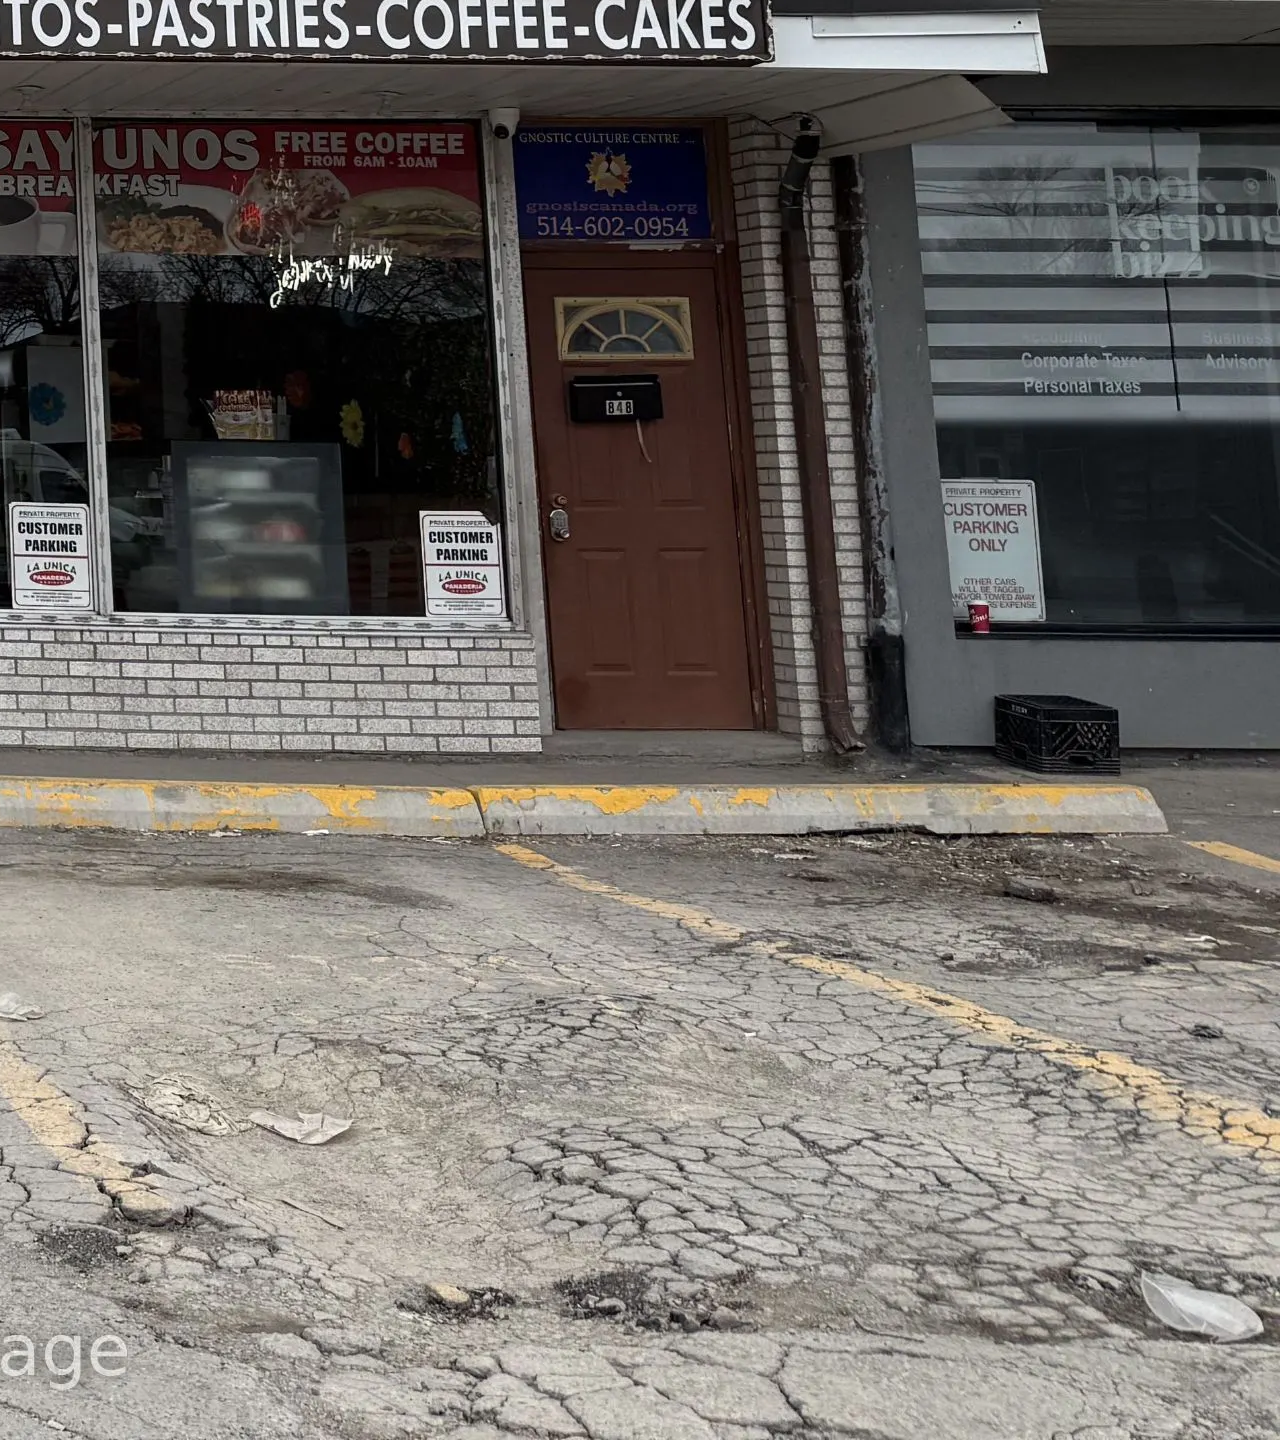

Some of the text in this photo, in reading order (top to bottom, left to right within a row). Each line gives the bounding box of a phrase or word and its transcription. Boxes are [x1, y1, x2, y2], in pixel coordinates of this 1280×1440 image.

[274, 131, 464, 155] FREE COFFEE
[519, 132, 680, 144] GNOSTIC CULTURE CENTRE
[304, 156, 438, 168] FROM 6AM 10AM
[526, 200, 698, 215] gnosiscanada.org
[537, 216, 689, 237] 514-602-0954
[1108, 203, 1280, 251] keeping
[1021, 352, 1147, 372] Corporate Taxes
[1205, 353, 1273, 371] Advisory
[1024, 376, 1141, 393] Personal Taxes
[608, 401, 632, 414] 848
[945, 488, 1021, 496] PRIVATE PROPERTY
[944, 503, 1027, 517] CUSTOMER
[18, 522, 83, 535] CUSTOMER
[953, 520, 1019, 534] PARKING
[429, 532, 493, 543] CUSTOMER
[25, 539, 77, 552] PARKING
[969, 538, 1007, 551] ONLY
[436, 549, 488, 560] PARKING
[27, 562, 76, 575] LA UNICA
[439, 571, 488, 583] LA UNICA
